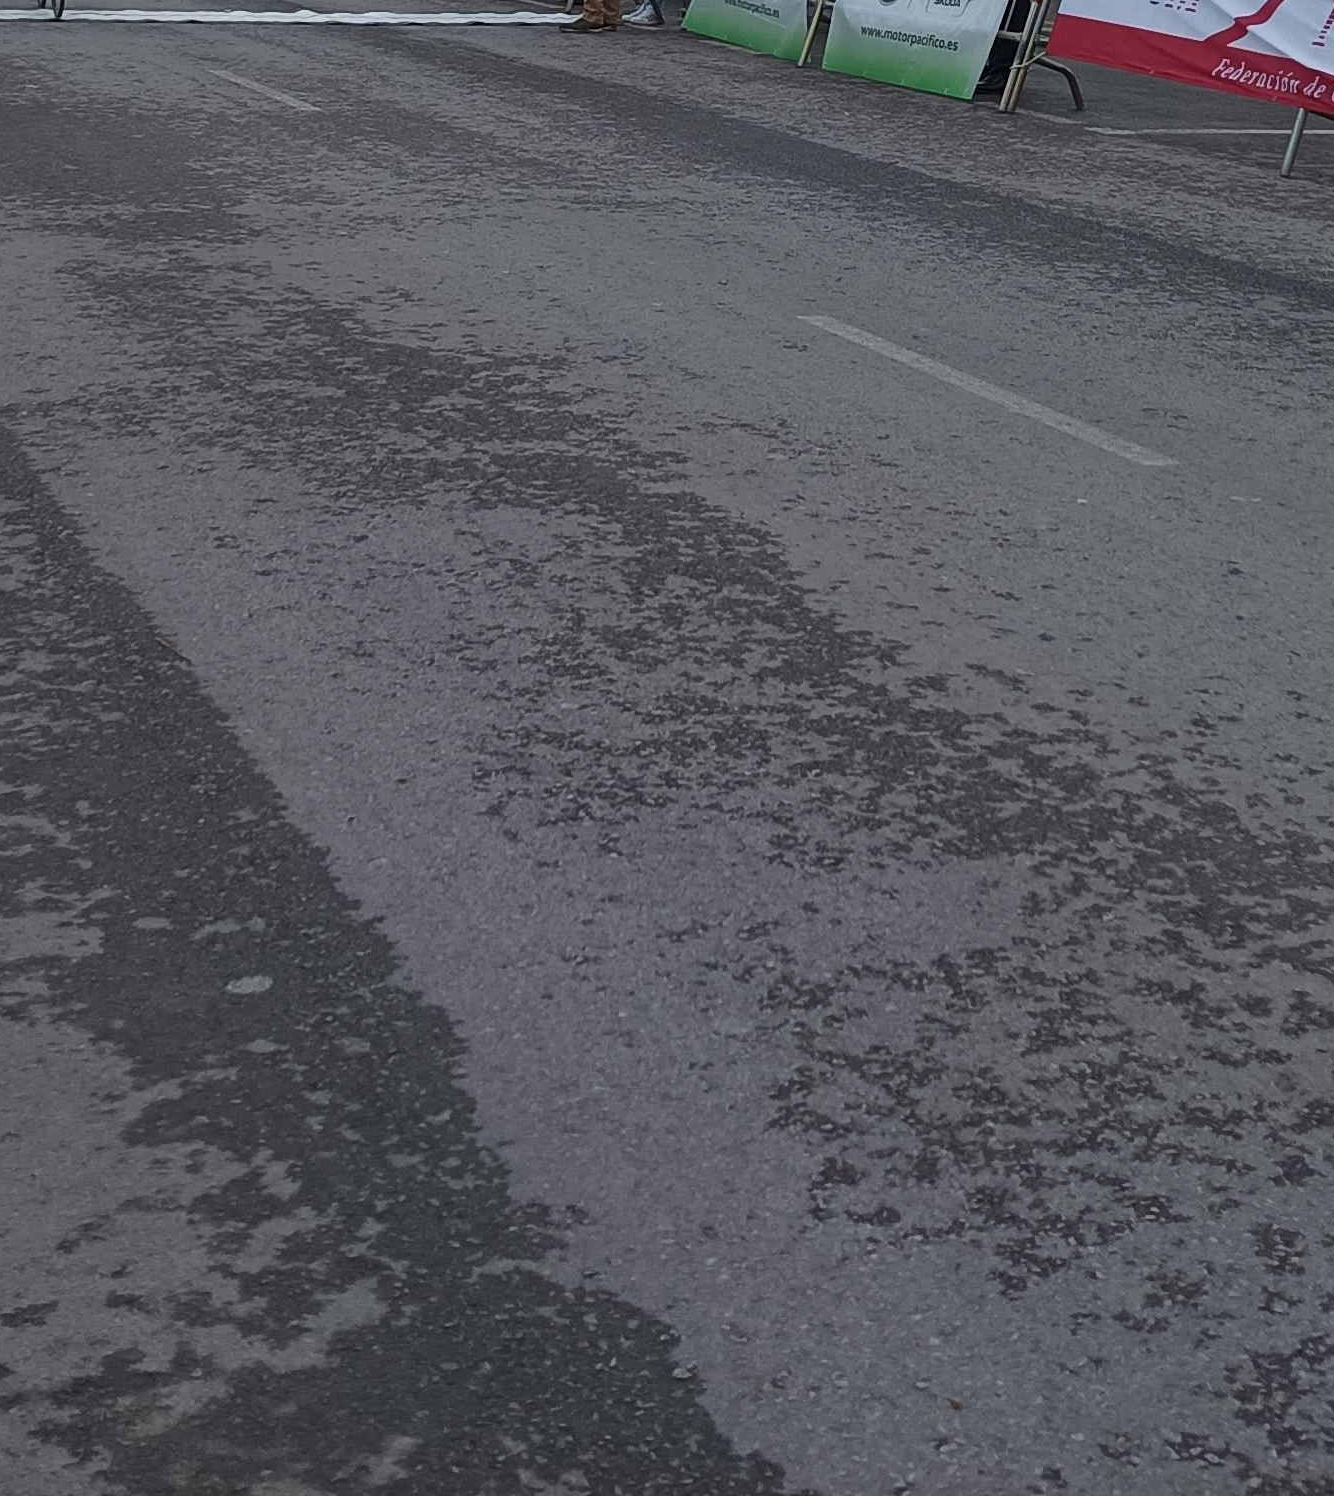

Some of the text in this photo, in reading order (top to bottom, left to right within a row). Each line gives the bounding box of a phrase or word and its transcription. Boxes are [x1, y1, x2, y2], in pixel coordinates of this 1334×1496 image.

[860, 25, 959, 52] www.motorpacifico.es
[1211, 57, 1300, 94] Federación
[1302, 74, 1326, 99] de
